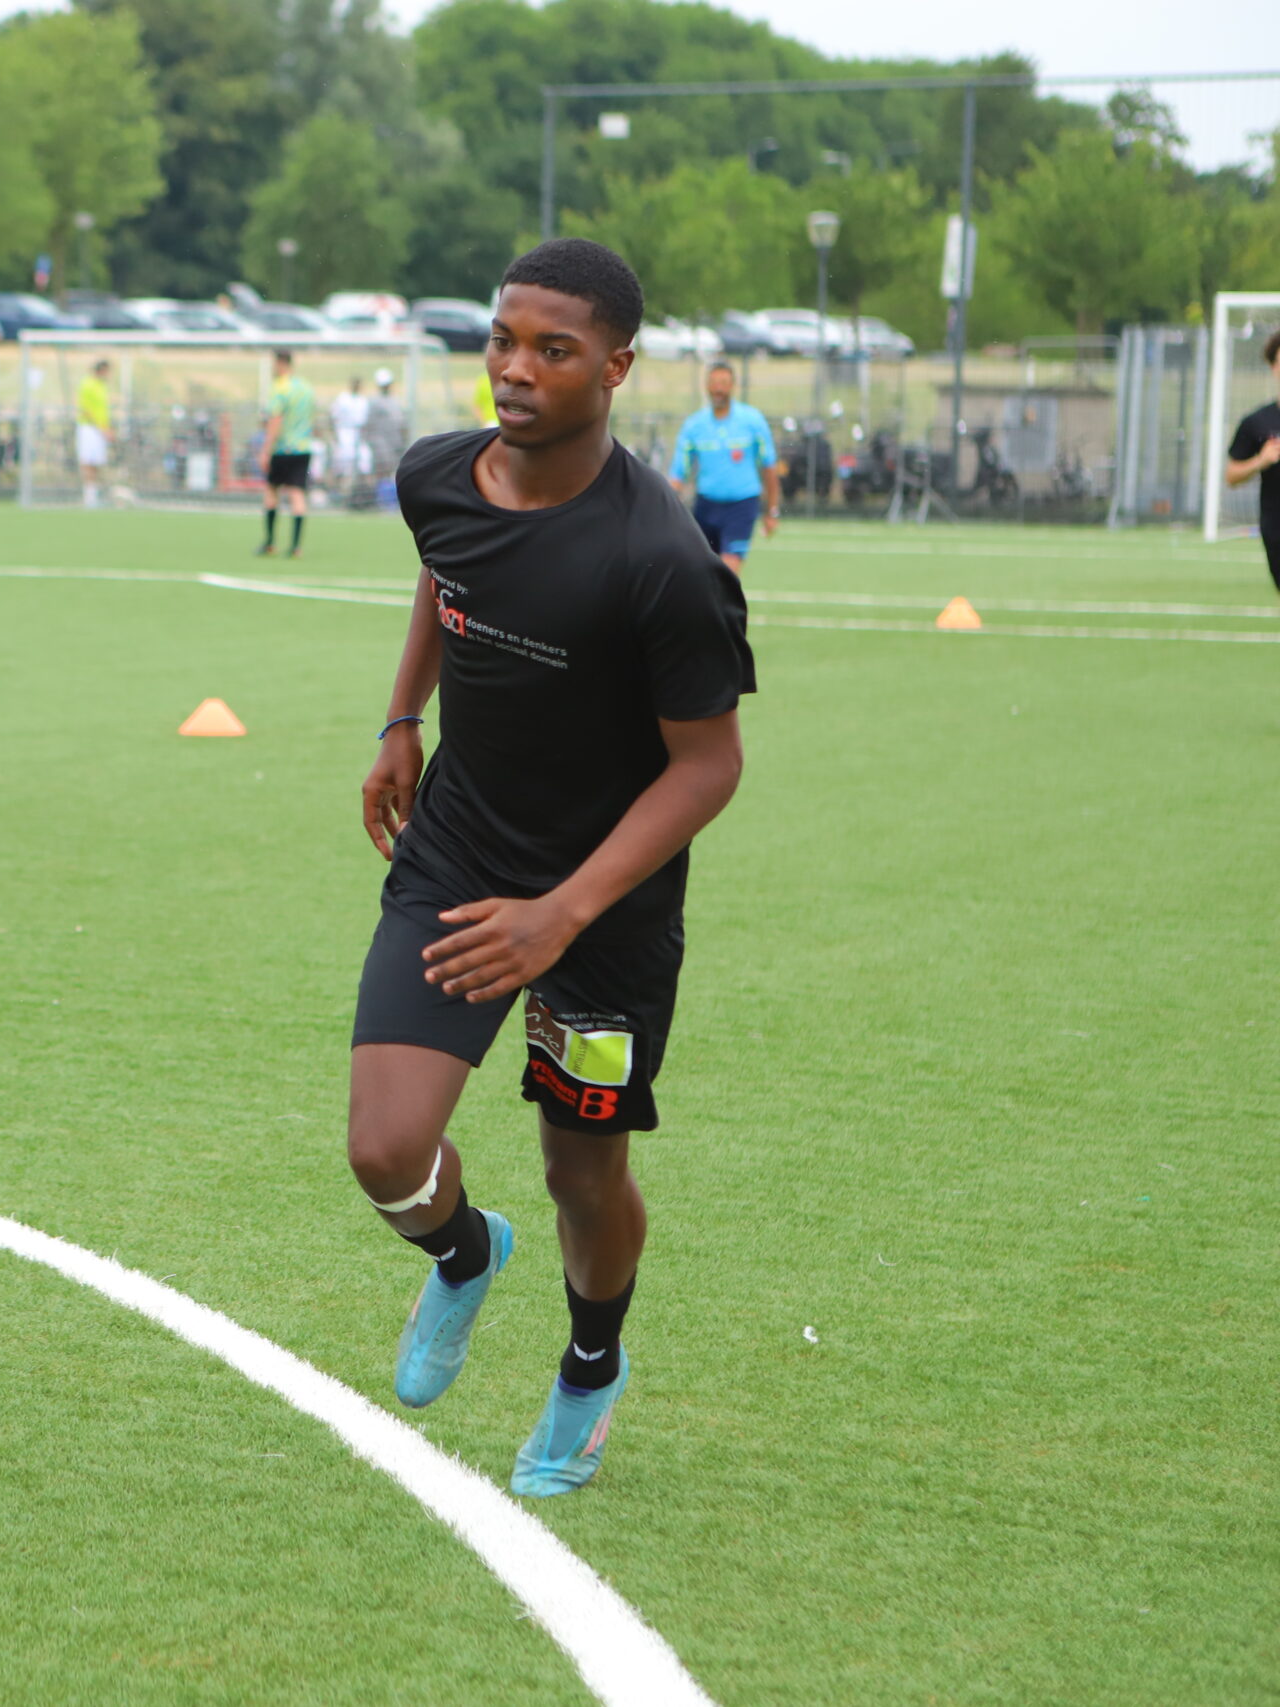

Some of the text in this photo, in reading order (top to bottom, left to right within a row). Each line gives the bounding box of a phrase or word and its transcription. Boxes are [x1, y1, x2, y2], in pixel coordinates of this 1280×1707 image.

[465, 616, 568, 657] doeners en denkers
[529, 651, 568, 670] domein
[578, 1087, 620, 1121] B
